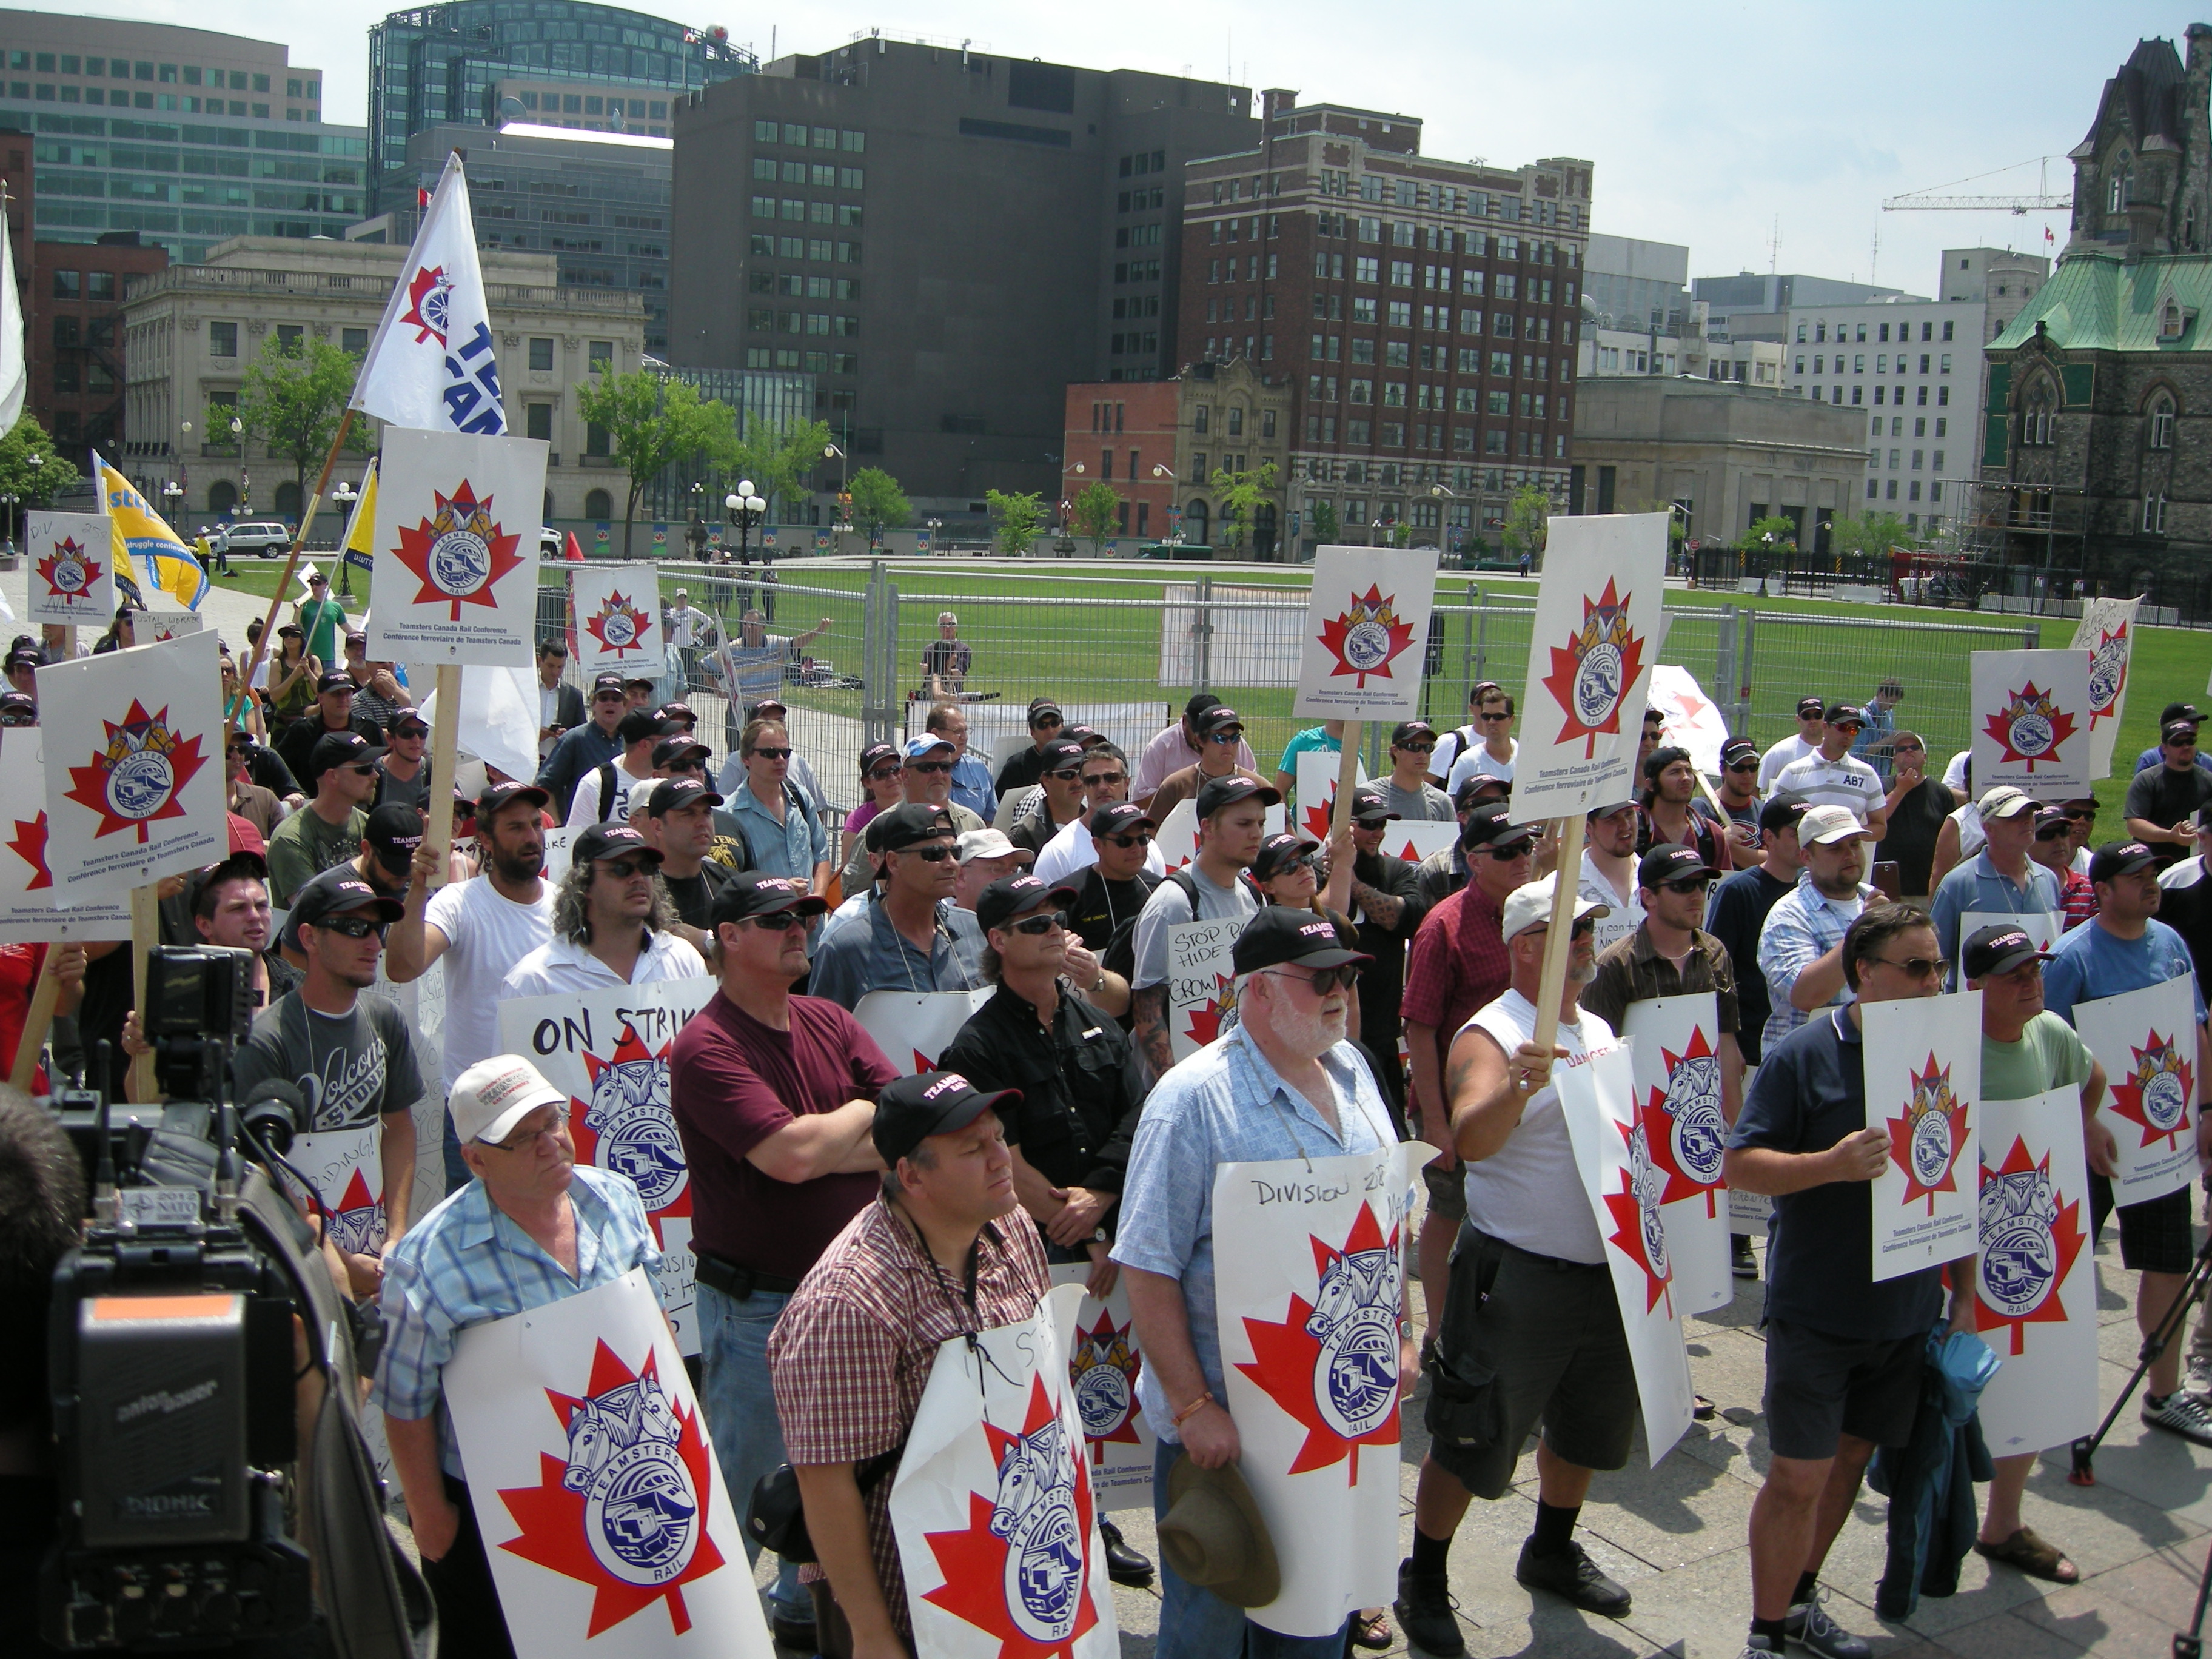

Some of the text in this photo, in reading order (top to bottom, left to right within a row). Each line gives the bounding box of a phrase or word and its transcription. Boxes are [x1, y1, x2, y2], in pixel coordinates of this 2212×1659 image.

[127, 540, 154, 550] struggle
[436, 531, 486, 551] TEAMSTERS
[133, 614, 200, 624] POSTAL WORKER
[399, 623, 432, 631] Teamsters
[154, 623, 176, 634] FOR
[1351, 622, 1387, 637] TEAMSTERS
[383, 632, 418, 641] Conférence
[420, 634, 455, 643] ferroviaire
[465, 636, 497, 645] Teamsters
[1582, 645, 1621, 668] TEAMSTERS
[1587, 716, 1601, 726] RAIL
[2013, 715, 2049, 728] TEAMSTERS
[113, 752, 167, 777] TEAMSTERS
[1539, 768, 1569, 778] Teamsters
[1569, 765, 1590, 775] Canada
[1590, 763, 1601, 771] Rail
[1524, 782, 1555, 795] Conférence
[1556, 779, 1586, 789] ferroviaire
[1612, 766, 1628, 778] Canada
[1843, 775, 1865, 788] A87
[133, 809, 151, 819] RAIL
[82, 830, 199, 867] Teamsters Canada Rail Conference
[67, 869, 104, 882] Conférence
[104, 860, 146, 874] ferroviaire
[157, 845, 191, 859] Teamsters
[191, 836, 215, 851] Canada
[1607, 924, 1624, 933] can
[1174, 930, 1220, 954] STOP
[1178, 946, 1221, 967] HIDE
[1169, 974, 1218, 1003] GROW
[532, 1008, 592, 1055] ON
[950, 1082, 968, 1092] RAIL
[2145, 1071, 2181, 1093] TEAMSTERS
[603, 1107, 679, 1141] TEAMSTERS
[1915, 1110, 1949, 1134] TEAMSTERS
[2134, 1162, 2160, 1172] Teamsters
[1702, 1171, 1718, 1182] RAIL
[1252, 1179, 1350, 1205] DIVISION
[156, 1202, 195, 1213] NATO
[1893, 1213, 1963, 1237] Teamsters Canada Rail Conference
[1982, 1217, 2050, 1247] TEAMSTERS
[1882, 1241, 1908, 1253] Conférence
[1908, 1235, 1931, 1246] ferroviaire
[1938, 1227, 1958, 1238] Teamsters
[1958, 1222, 1972, 1233] Canada
[2007, 1302, 2032, 1314] RAIL
[1078, 1366, 1126, 1387] TEAMSTERS
[1349, 1420, 1372, 1433] RAIL
[593, 1443, 680, 1503] TEAMSTERS
[1117, 1464, 1153, 1473] Conference
[1111, 1478, 1143, 1487] Teamsters
[654, 1560, 685, 1581] RAIL
